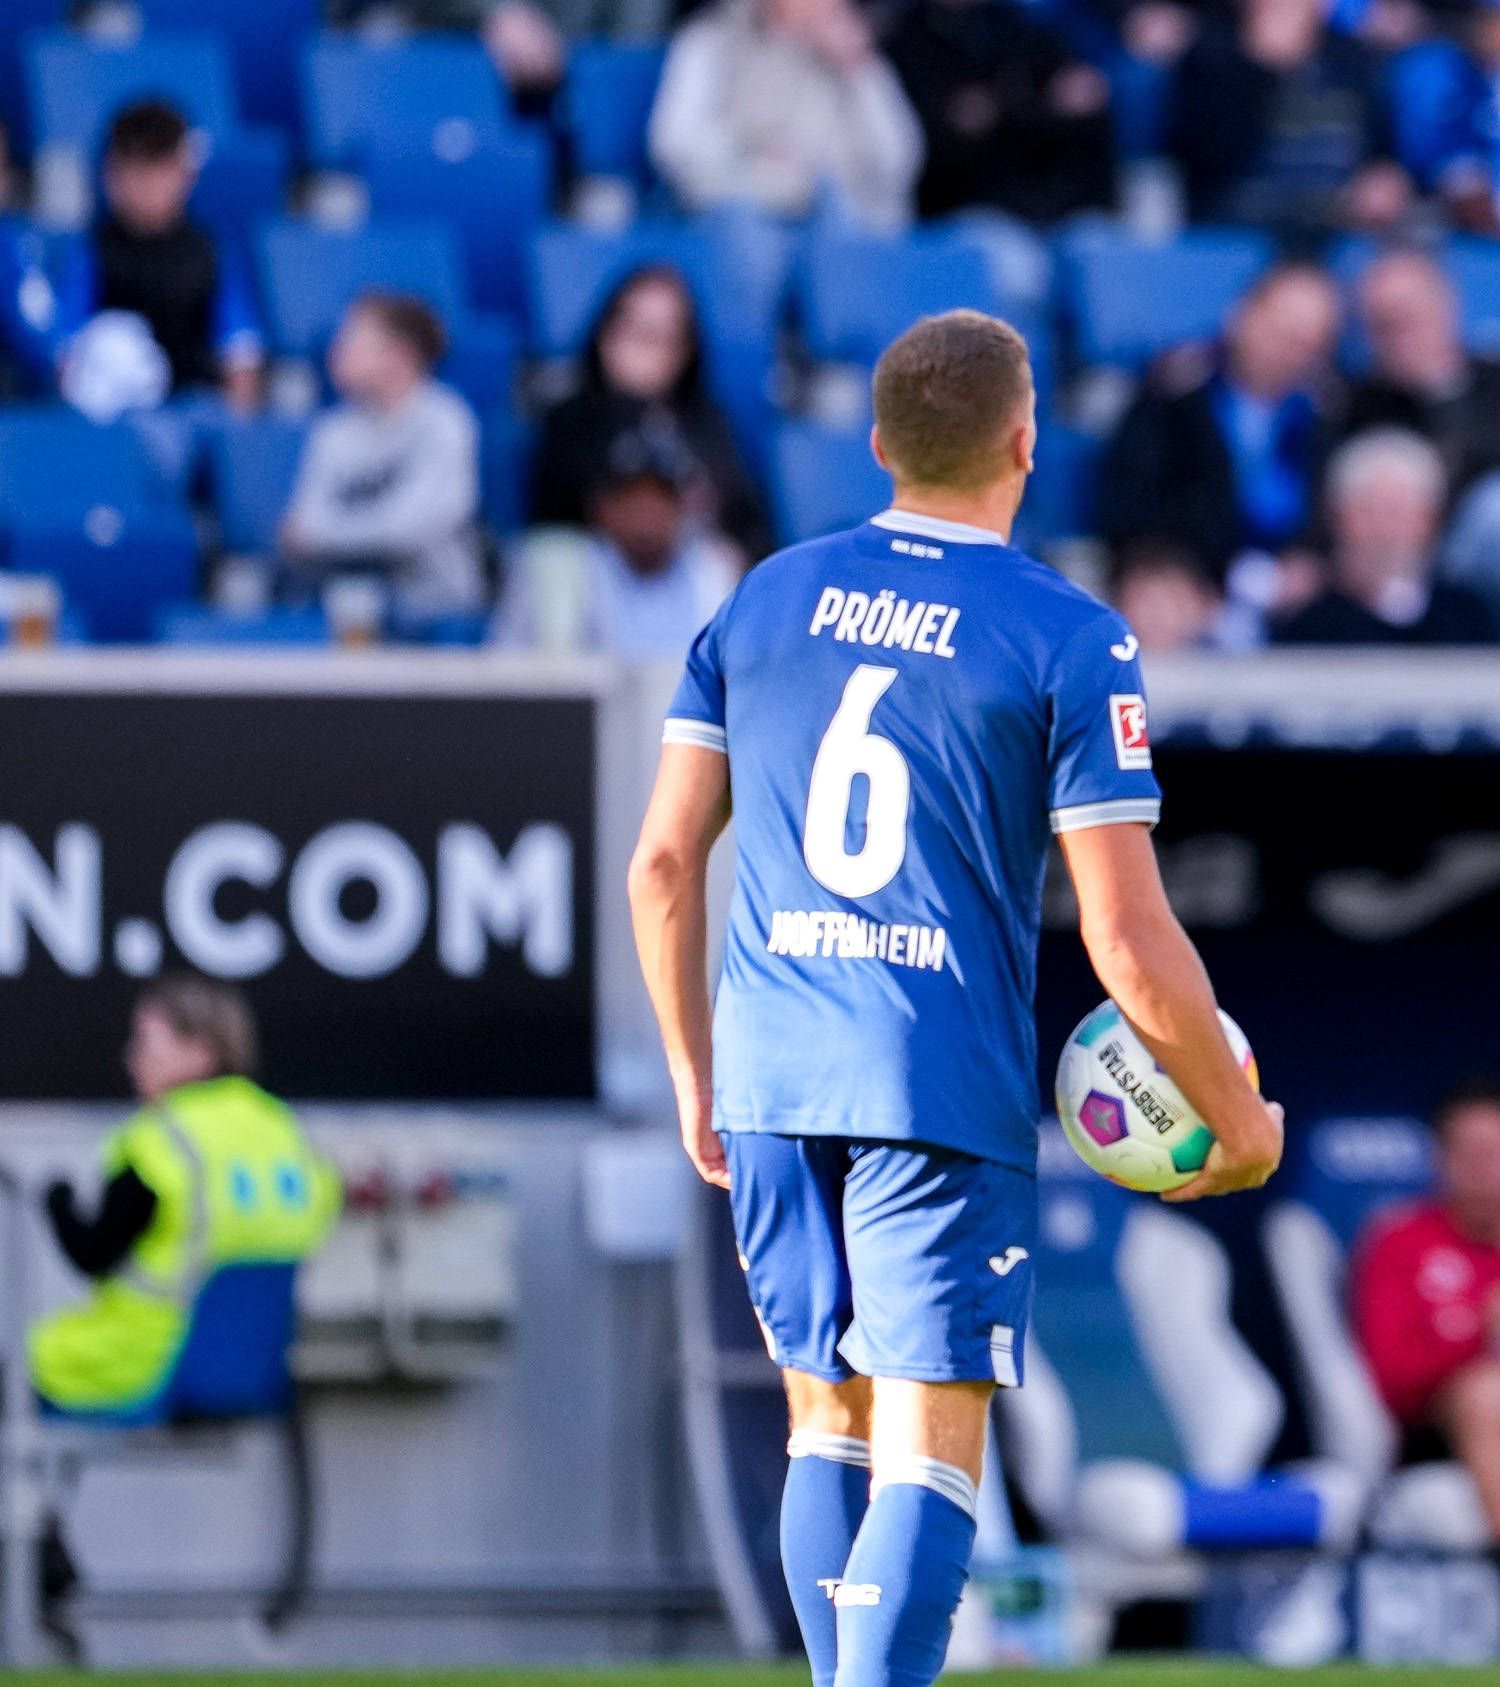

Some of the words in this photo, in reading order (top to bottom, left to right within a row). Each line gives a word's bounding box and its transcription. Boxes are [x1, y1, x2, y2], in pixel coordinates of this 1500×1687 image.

[809, 585, 961, 659] PRÖMEL
[804, 663, 911, 899] 6
[0, 819, 574, 979] N.COM
[1097, 1042, 1175, 1135] DERBYSTAR
